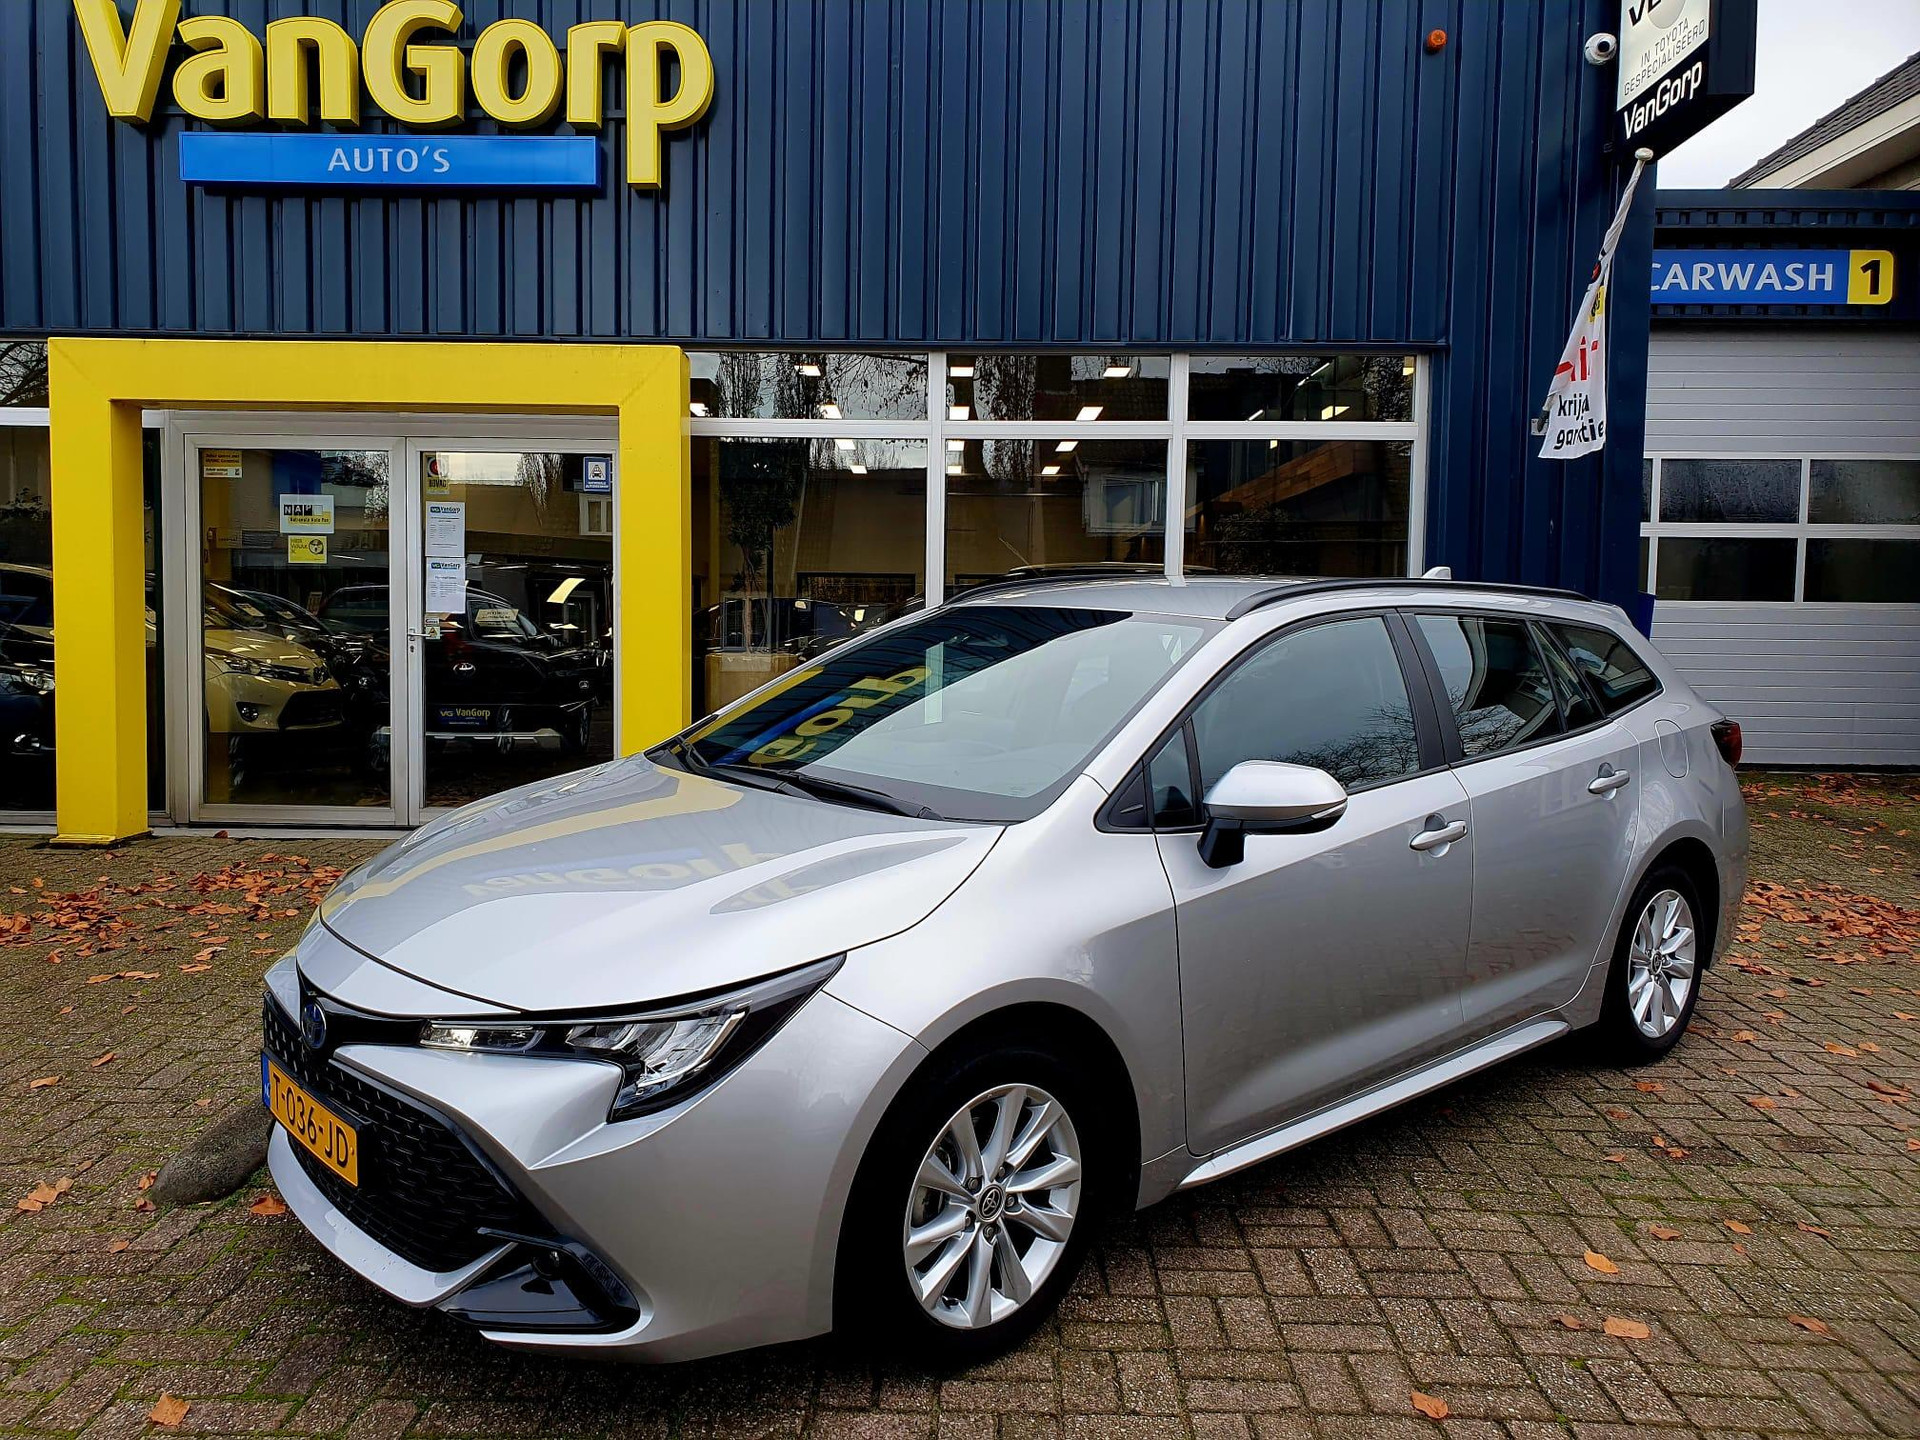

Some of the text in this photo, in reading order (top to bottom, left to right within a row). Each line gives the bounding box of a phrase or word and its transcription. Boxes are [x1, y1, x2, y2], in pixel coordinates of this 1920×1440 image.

[1624, 19, 1705, 96] GESPECIALISEERD
[1641, 17, 1689, 67] IN TOYOTA
[73, 0, 714, 190] VanGorp
[1623, 61, 1703, 140] VanGorp
[327, 145, 450, 173] AUTO'S
[1859, 259, 1881, 295] 1
[284, 504, 312, 515] NAP
[456, 708, 490, 720] VanGorp
[272, 1071, 349, 1168] T-036-JD
